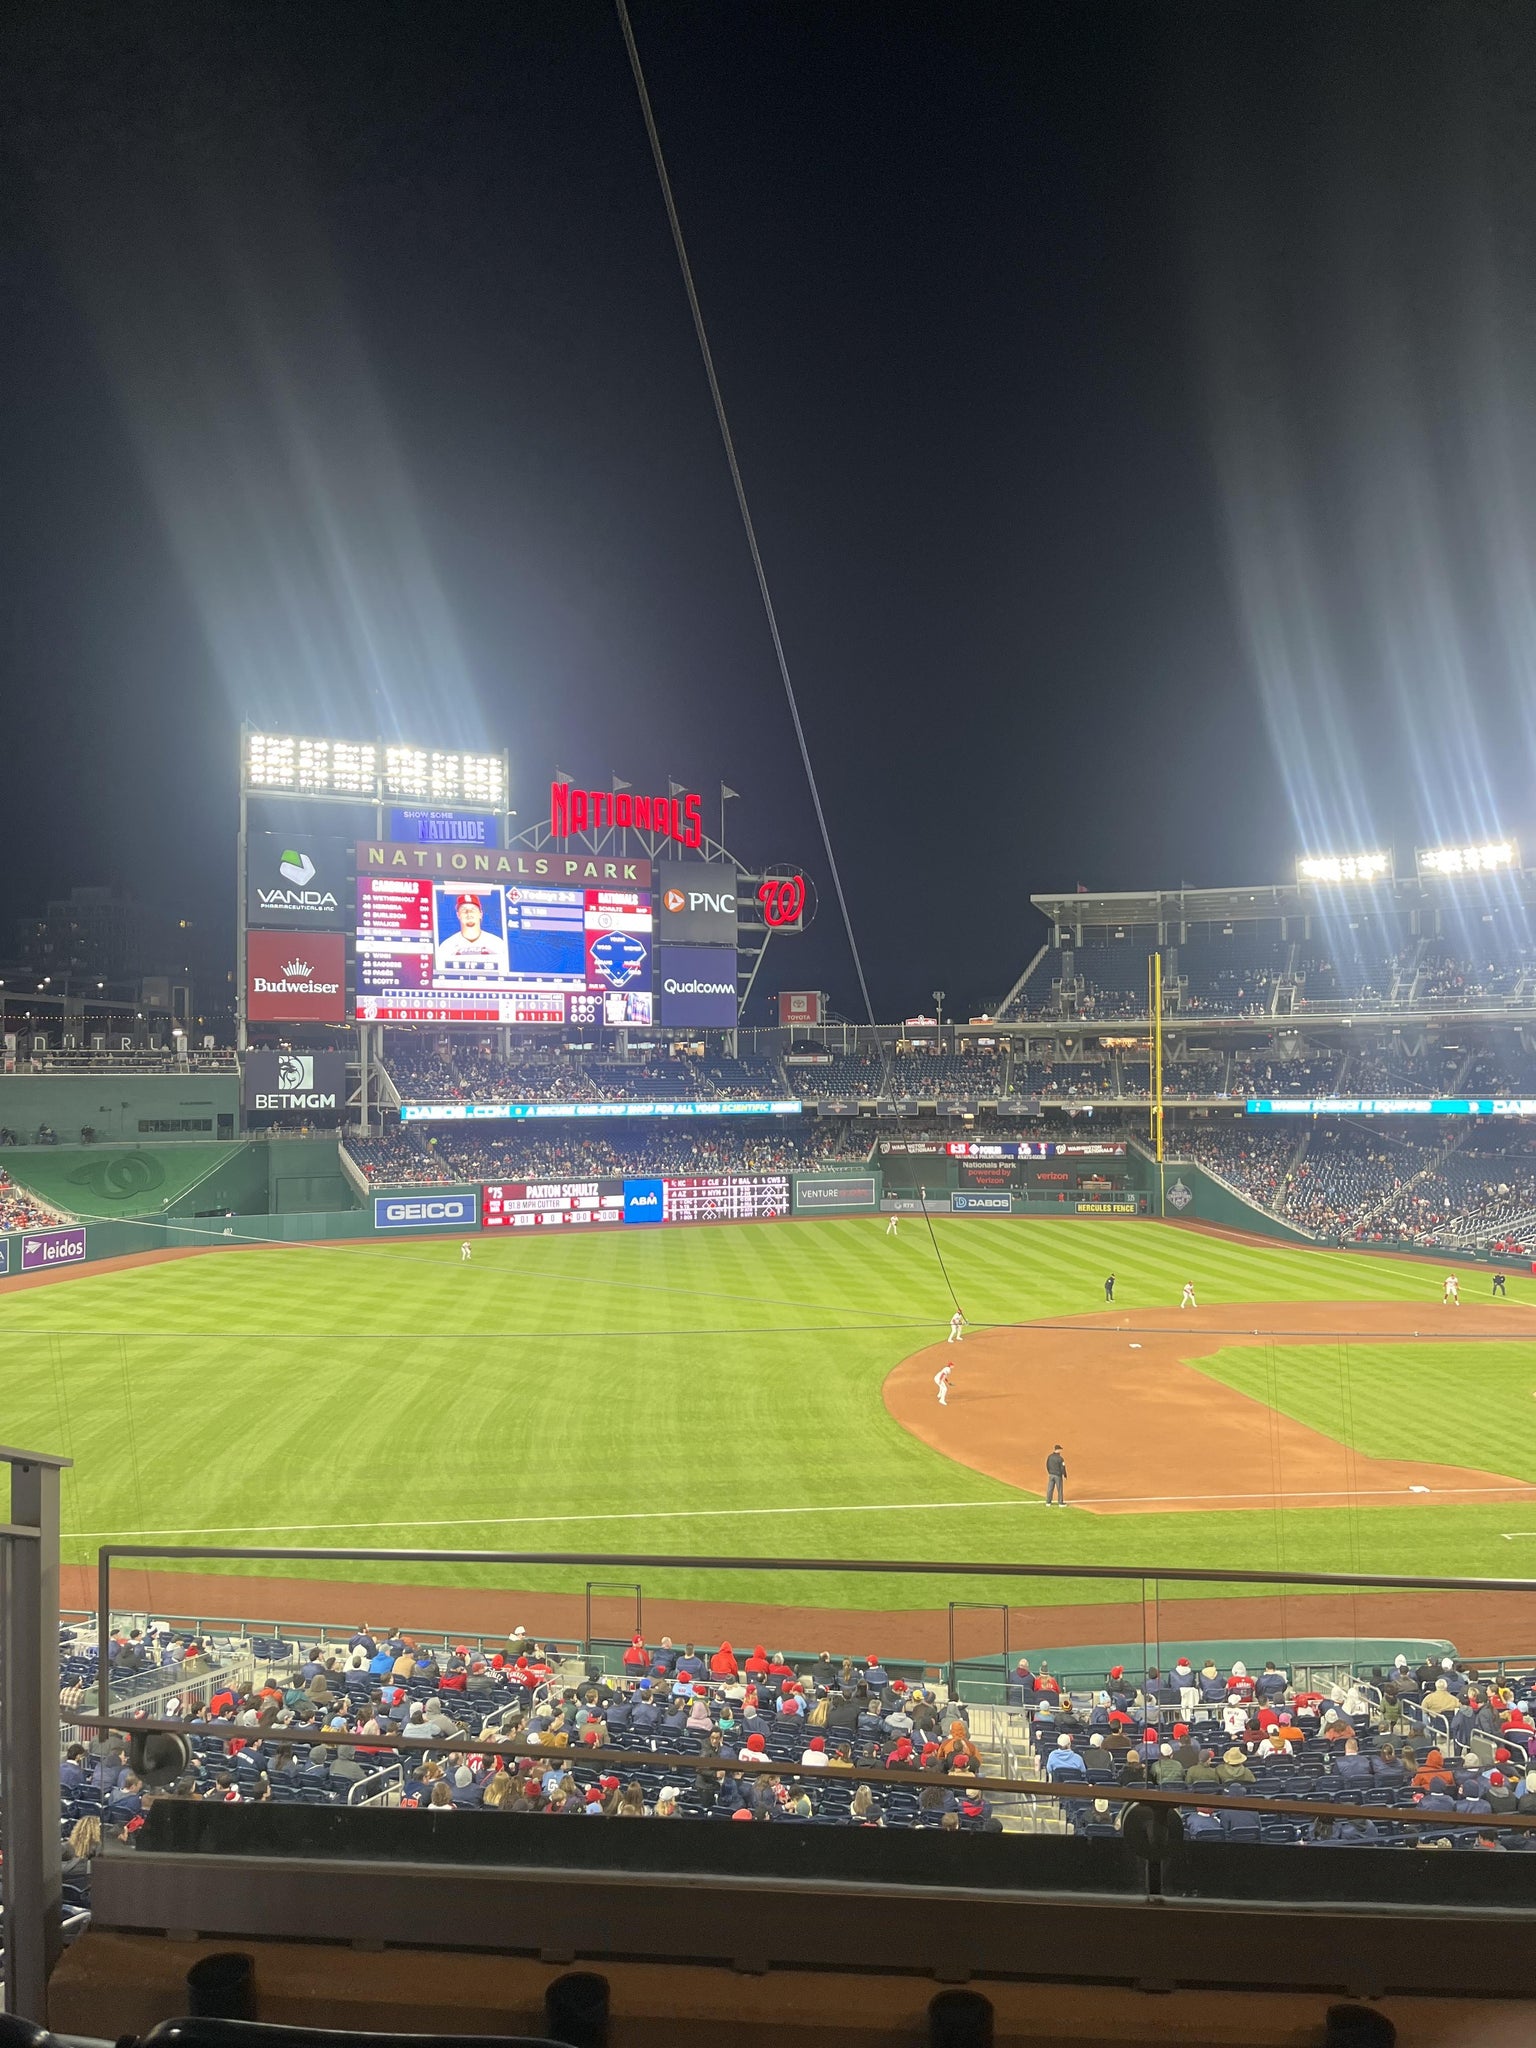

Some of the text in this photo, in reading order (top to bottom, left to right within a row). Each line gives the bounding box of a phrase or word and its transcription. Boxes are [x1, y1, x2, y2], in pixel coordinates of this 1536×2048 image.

[551, 782, 701, 848] NATIONALS
[418, 820, 485, 840] NATITUDE
[369, 848, 637, 880] NATIONALS PARK
[257, 888, 338, 906] VANDA
[688, 892, 735, 912] PNC
[372, 920, 400, 928] WALKER
[254, 977, 339, 994] Budweiser
[664, 979, 735, 994] Qualcomm
[542, 1002, 548, 1010] 2
[402, 1010, 407, 1018] 0
[440, 1011, 446, 1019] 2
[542, 1012, 548, 1020] 3
[256, 1094, 336, 1109] BETMGM
[676, 1104, 694, 1114] ALL
[722, 1104, 770, 1112] SCIENTIFIC
[1002, 1169, 1011, 1177] by
[1036, 1172, 1068, 1180] verizon
[976, 1176, 1004, 1184] Verizon
[526, 1185, 560, 1198] PAXTON
[562, 1183, 598, 1197] SCHULTZ
[678, 1190, 686, 1198] AZ
[802, 1189, 838, 1198] VENTURE
[537, 1200, 560, 1208] CUTTER
[630, 1196, 658, 1206] ABM
[386, 1202, 464, 1220] GEICO
[1078, 1204, 1112, 1212] HERCULES
[43, 1239, 84, 1260] leidos
[1229, 1716, 1235, 1726] 4
